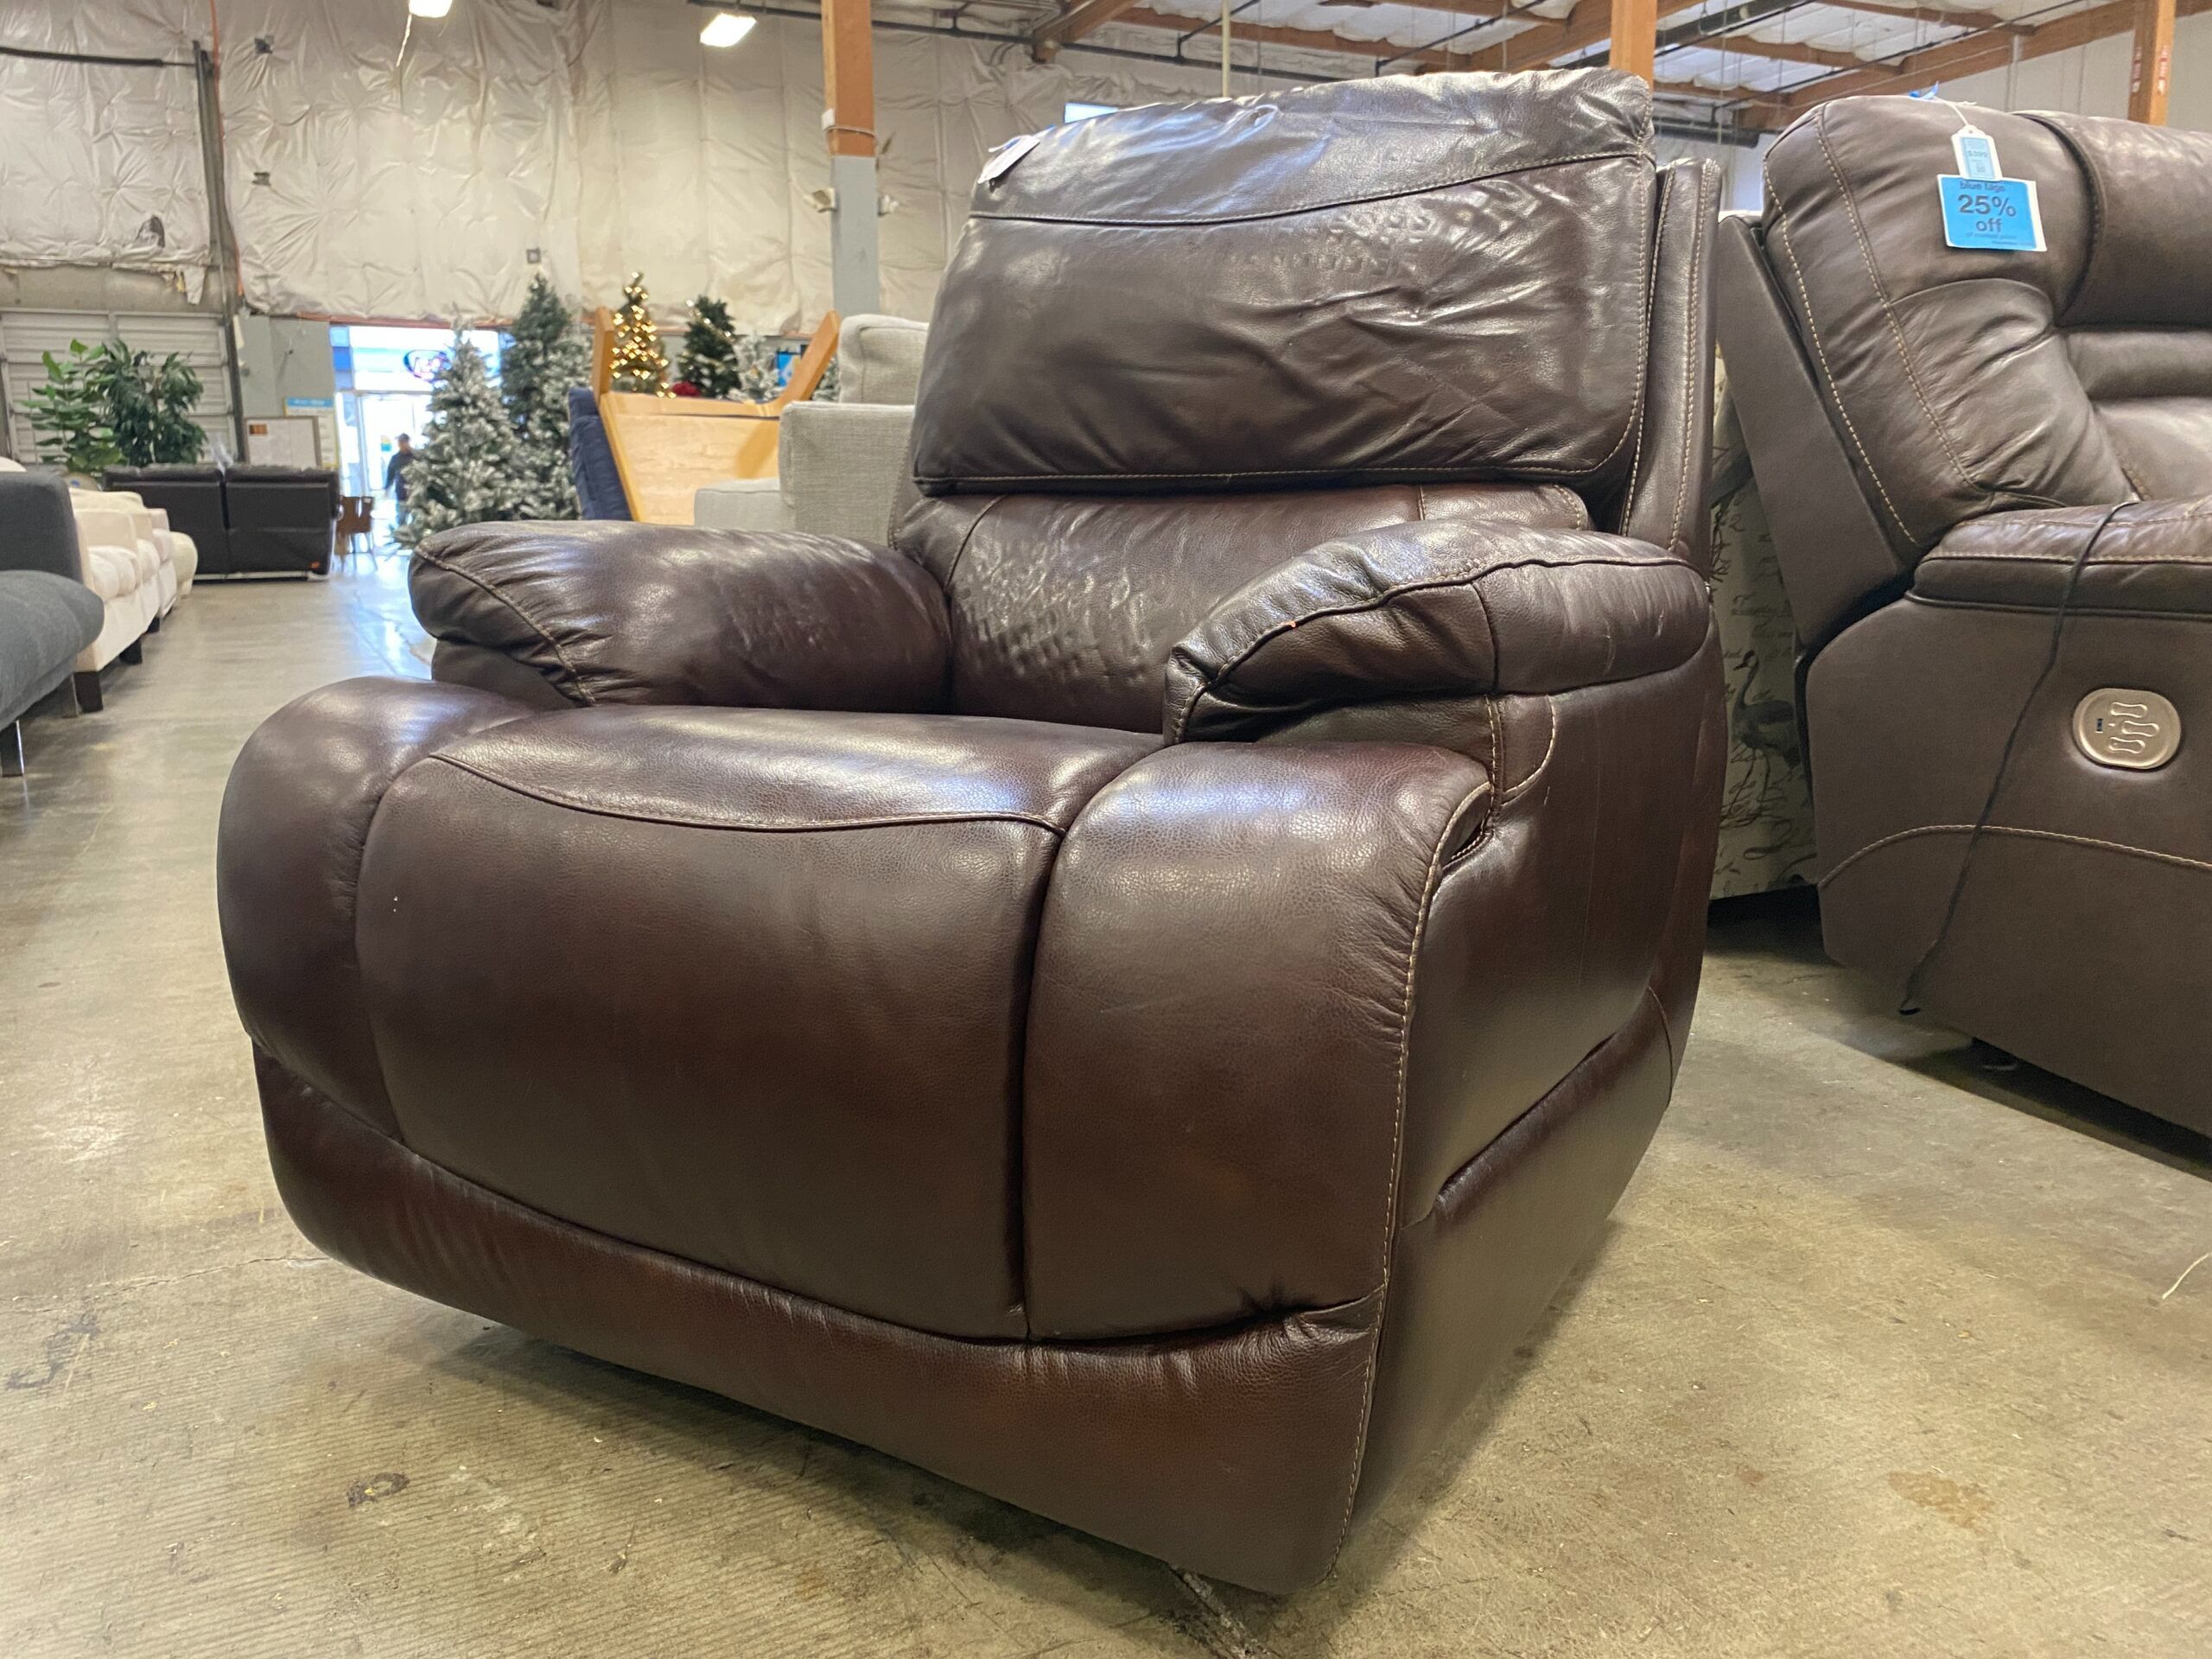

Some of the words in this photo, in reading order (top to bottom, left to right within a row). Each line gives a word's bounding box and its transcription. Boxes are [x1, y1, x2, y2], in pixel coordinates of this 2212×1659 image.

[1960, 180, 1982, 190] blue
[1957, 194, 2017, 217] 25%
[1975, 218, 2002, 232] off
